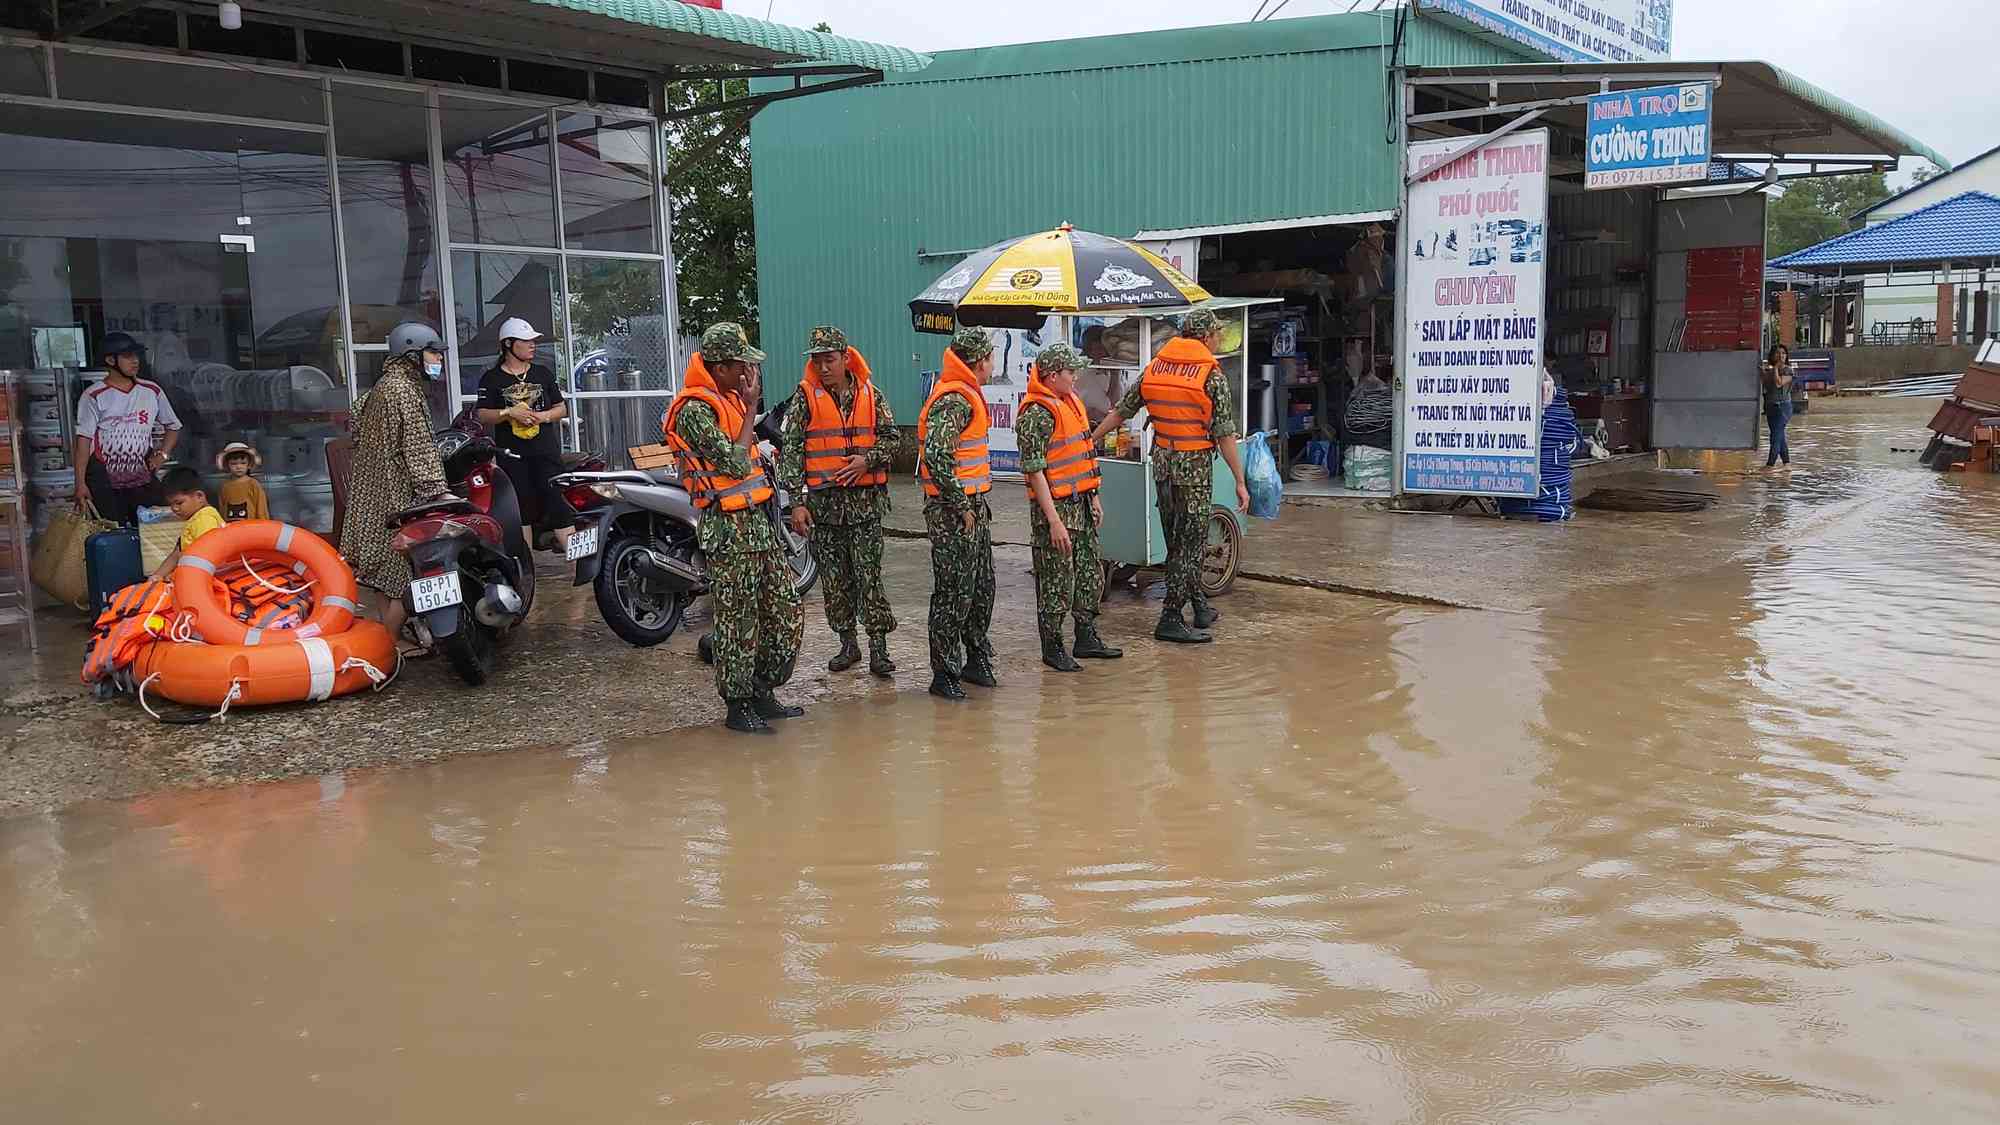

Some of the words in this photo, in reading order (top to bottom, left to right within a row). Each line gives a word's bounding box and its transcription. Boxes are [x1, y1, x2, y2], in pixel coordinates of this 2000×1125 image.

[1501, 0, 1530, 22] TRANG
[1531, 8, 1544, 29] TRÍ
[1546, 14, 1560, 38] NỘI
[1562, 22, 1581, 46] THẤT
[1582, 31, 1592, 50] VÀ
[1593, 35, 1606, 56] CÁC
[1574, 1, 1590, 22] LIỆU
[1591, 9, 1606, 28] XÂY
[1606, 16, 1625, 37] DỰNG
[1594, 95, 1634, 121] NHÀ
[1639, 94, 1679, 117] TRỌ
[1591, 123, 1648, 164] CƯỜNG
[1652, 124, 1706, 165] THỊNH
[1483, 144, 1544, 179] THỊNH
[1439, 188, 1473, 217] PHÚ
[1475, 181, 1520, 218] QUỐC
[1046, 291, 1070, 303] Dũng
[1435, 269, 1517, 307] CHUYÊN
[1422, 319, 1446, 343] SAN
[1449, 312, 1471, 341] LẤP
[1473, 314, 1500, 345] MẶT
[1503, 309, 1537, 340] BẰNG
[1418, 351, 1442, 367] KINH
[1444, 350, 1477, 367] DOANH
[1479, 346, 1503, 369] ĐIỆN
[1417, 375, 1436, 396] VẬT
[1437, 375, 1458, 397] LIỆU
[1460, 374, 1479, 394] XÂY
[1482, 377, 1510, 397] DỰNG
[1417, 405, 1449, 421] TRANG
[1452, 400, 1468, 421] TRÍ
[1469, 401, 1487, 425] NỘI
[1489, 399, 1516, 422] THẤT
[1519, 402, 1532, 421] VÀ
[1415, 429, 1432, 448] CÁC
[1434, 427, 1463, 448] THIẾT
[1465, 433, 1475, 452] BỊ
[1477, 429, 1498, 449] XÂY
[571, 529, 592, 546] 68-P1
[419, 575, 451, 594] 68-P1
[418, 589, 459, 610] 150.41
